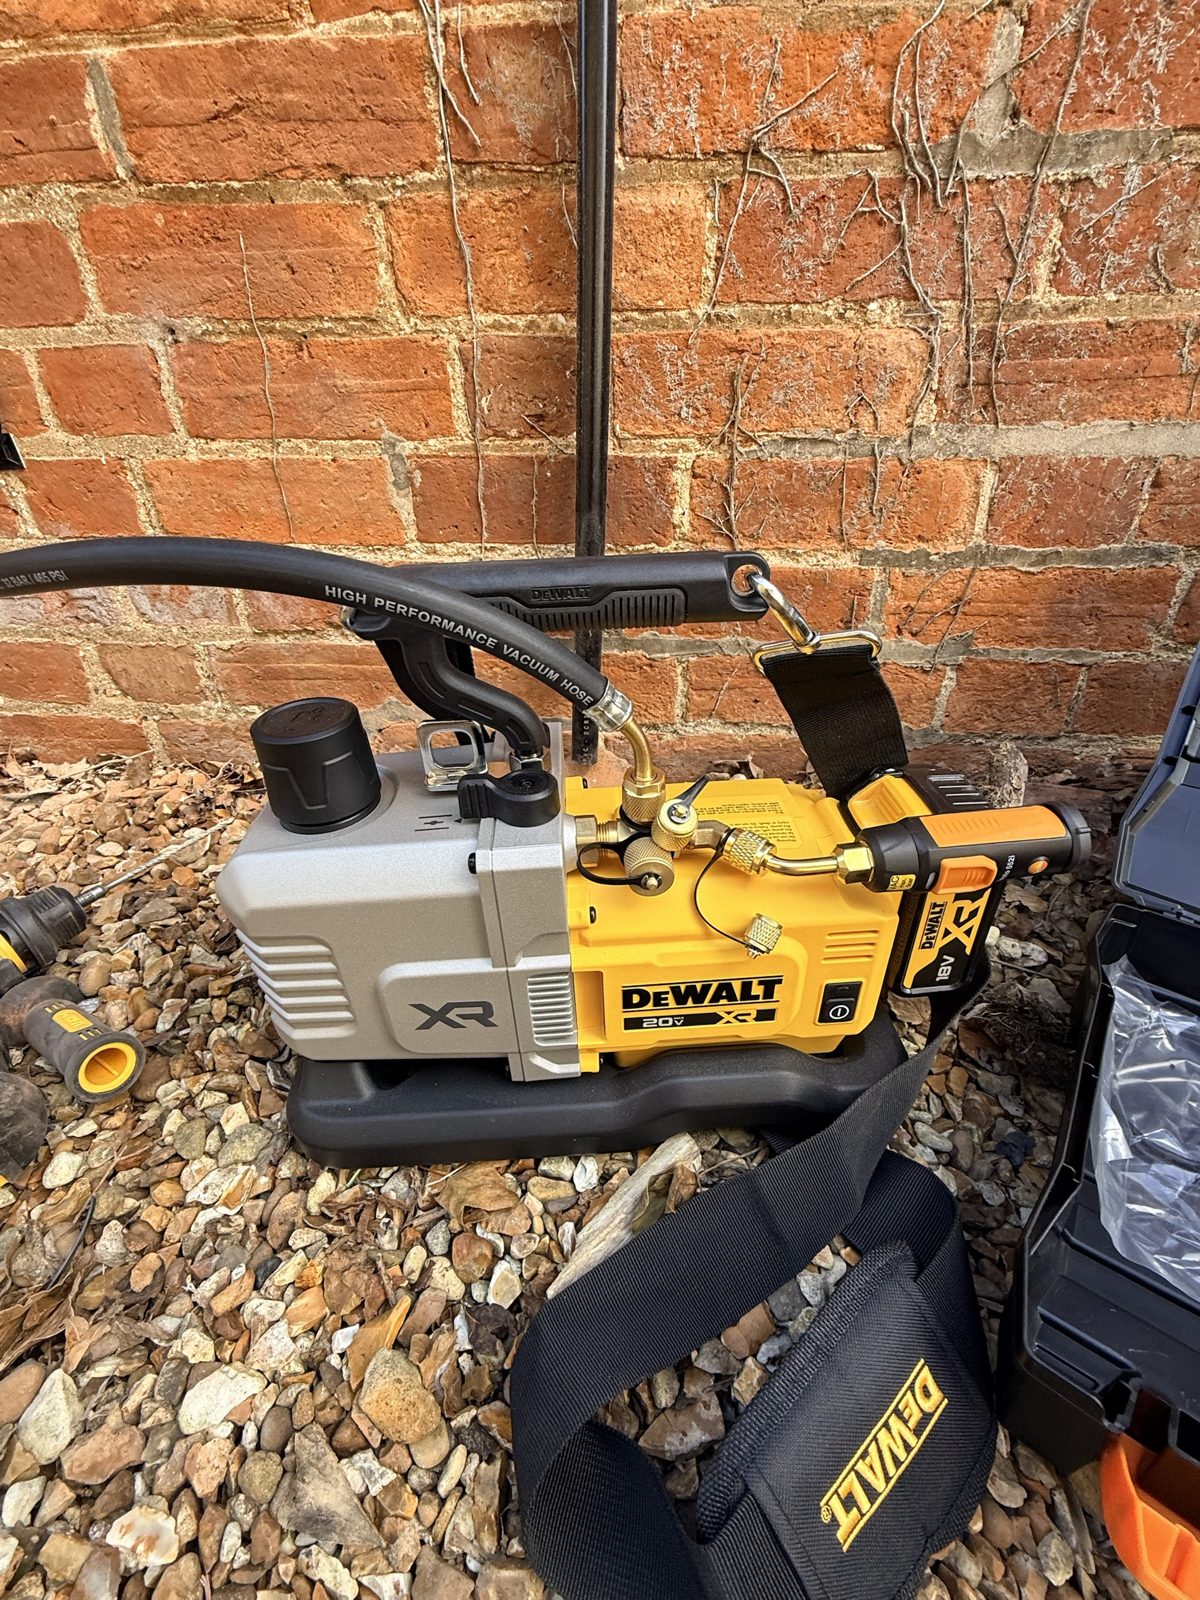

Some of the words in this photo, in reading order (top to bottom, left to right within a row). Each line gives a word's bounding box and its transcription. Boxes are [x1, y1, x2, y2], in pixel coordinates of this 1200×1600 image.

[12, 574, 32, 587] BAR
[33, 571, 51, 583] 465
[48, 569, 69, 582] PSI
[324, 585, 366, 605] HIGH
[374, 597, 498, 649] PERFORMANCE
[502, 644, 560, 683] VACUUM
[560, 678, 594, 706] HOSE
[921, 901, 944, 949] DEWALT
[936, 955, 955, 981] 18V
[622, 979, 783, 1010] DEWALT
[408, 1001, 498, 1031] XR
[715, 1009, 758, 1025] XR
